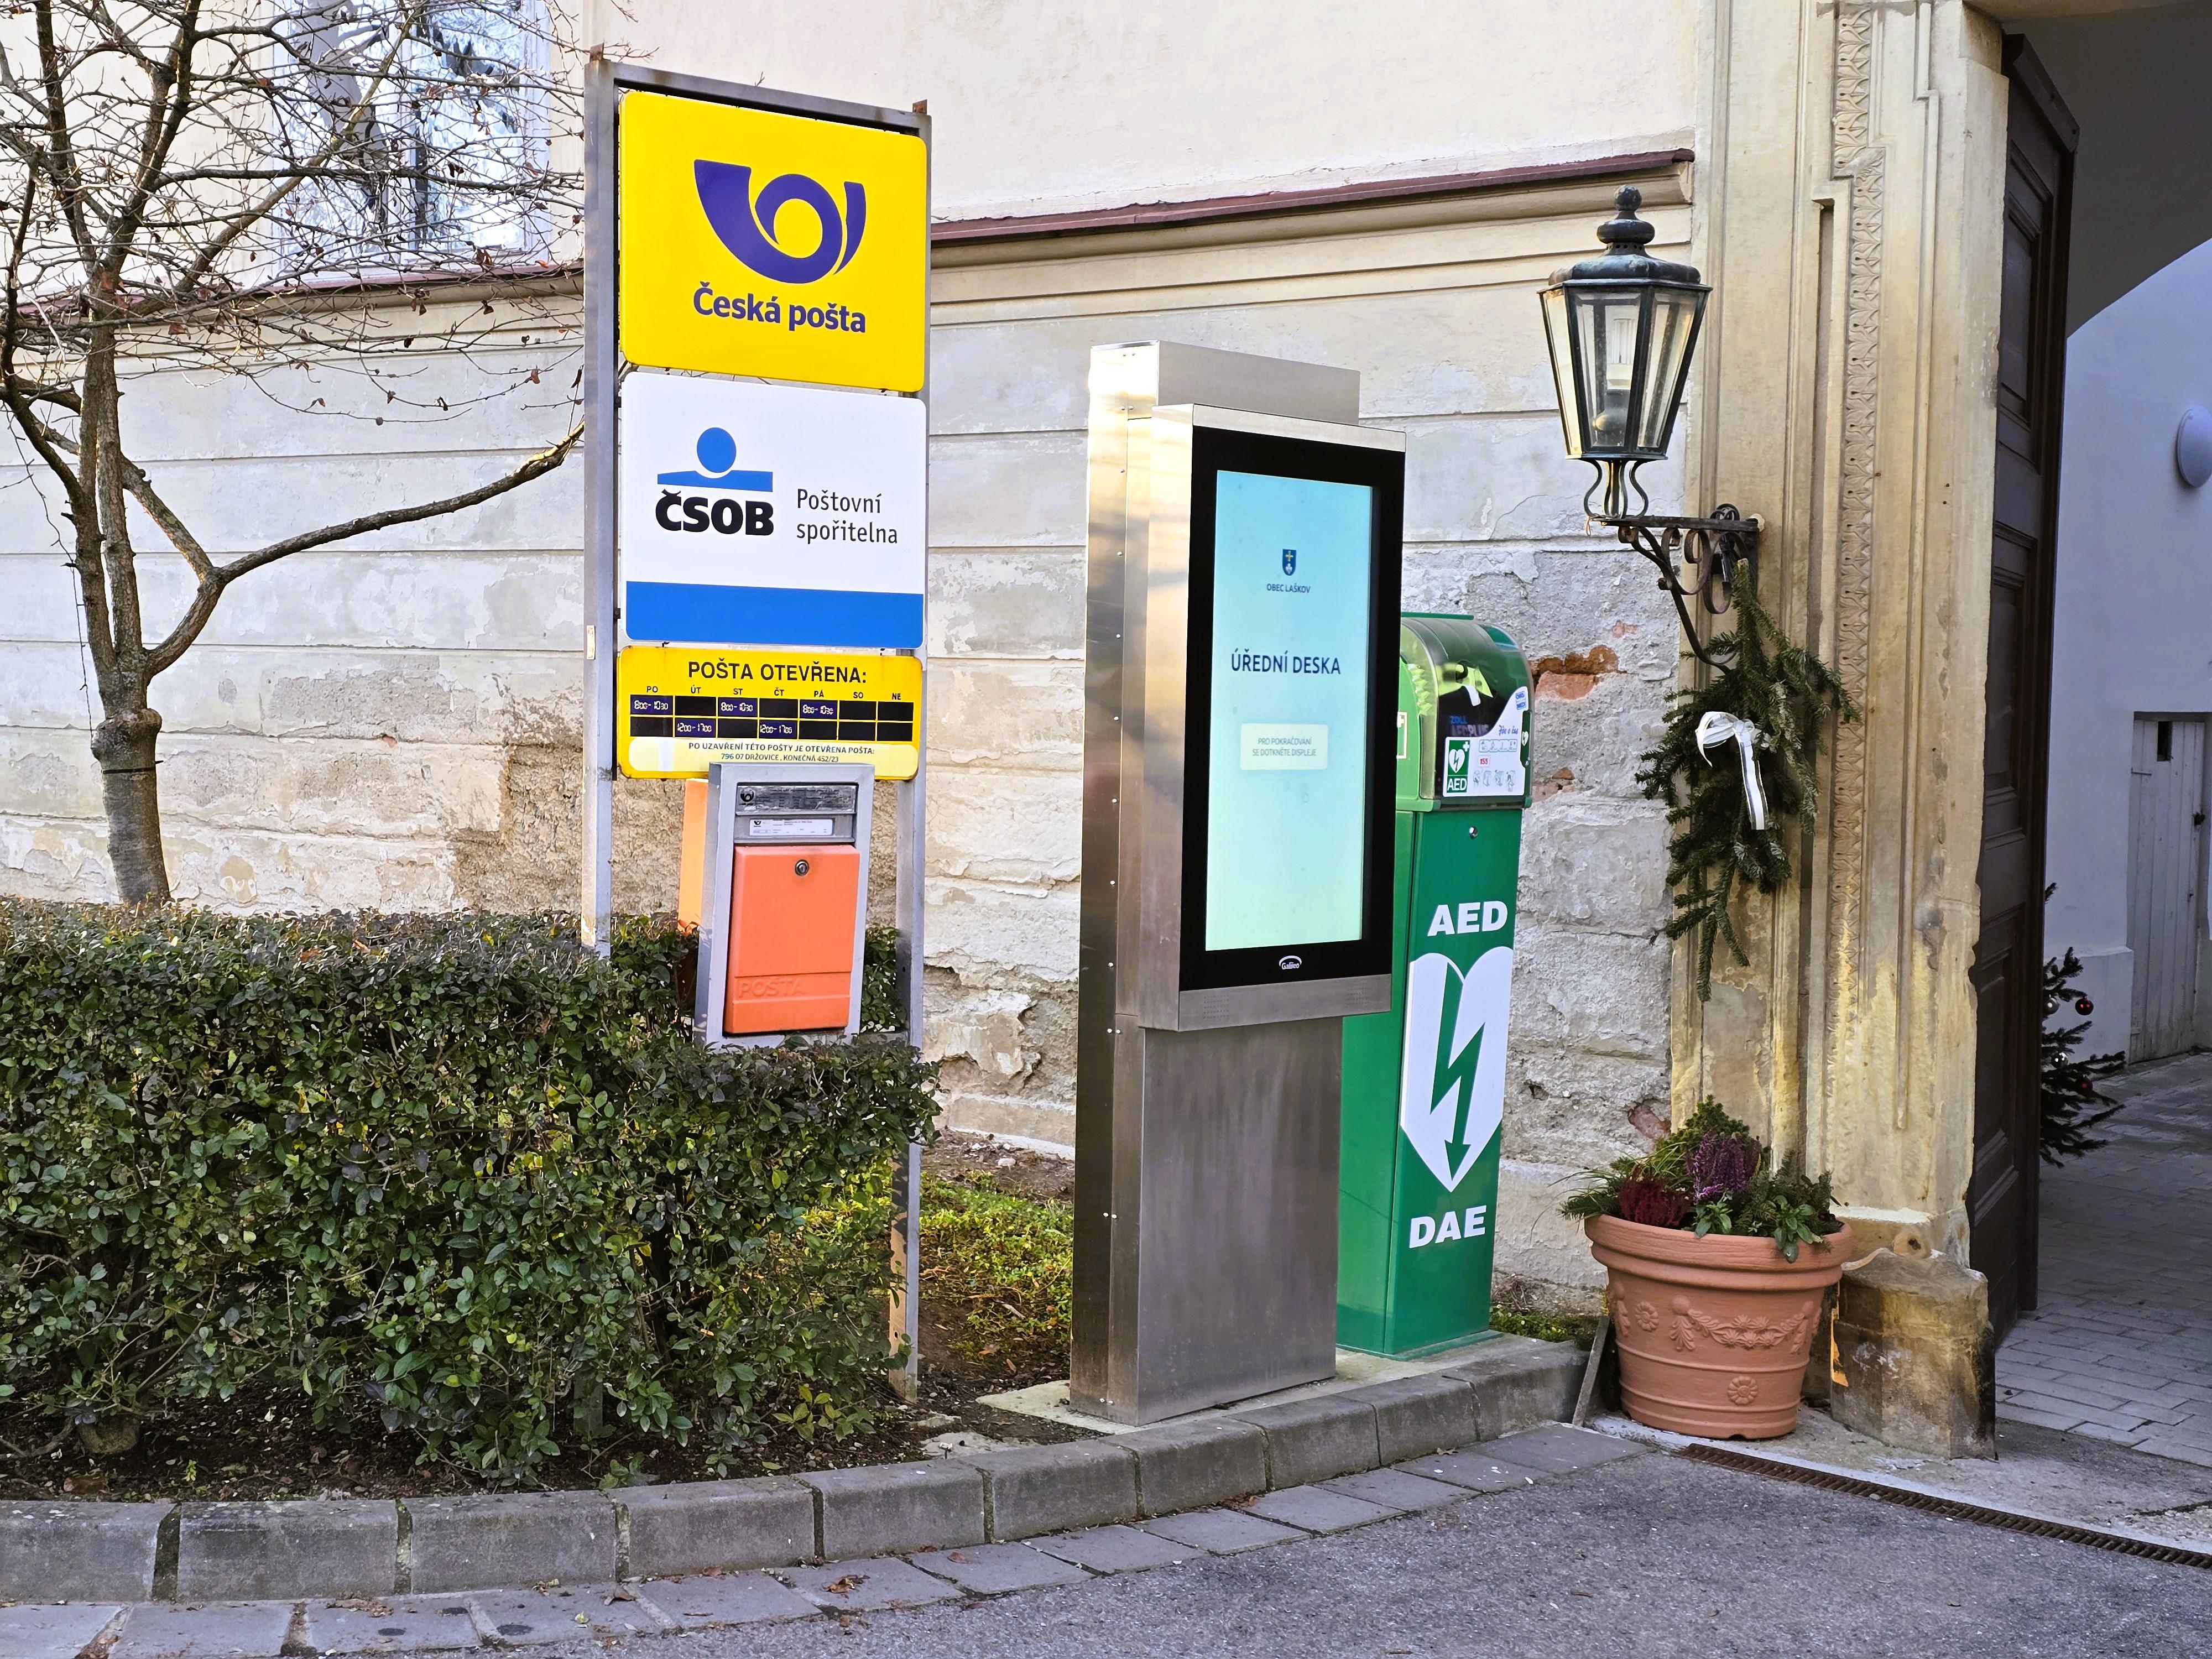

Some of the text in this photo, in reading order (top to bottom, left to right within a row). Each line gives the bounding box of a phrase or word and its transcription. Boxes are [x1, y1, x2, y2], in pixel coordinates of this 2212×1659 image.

[693, 281, 866, 333] Česká pošta
[655, 488, 774, 536] ČSOB
[797, 488, 882, 514] Poštovní
[796, 519, 898, 545] spořitelna
[1266, 583, 1311, 593] OBEC LAŠKOV
[688, 657, 867, 684] POŠTA OTEVŘENA:
[1231, 647, 1341, 675] ÚŘEDNÍ DESKA
[646, 685, 659, 693] PO
[690, 684, 702, 694] ÚT
[773, 687, 785, 697] ČT
[813, 689, 825, 698] PÁ
[702, 742, 743, 751] UZAVŘENÍ
[745, 742, 766, 751] TÉTO
[768, 744, 793, 753] POŠTY
[805, 745, 847, 754] OTEVŘENA
[1252, 747, 1317, 757] SE DOTKNĚTE DISPLEJE
[1258, 736, 1312, 746] PRO POKRAČOVÁNÍ
[783, 754, 816, 762] KONEČNÁ
[1447, 778, 1467, 791] AED
[1427, 901, 1508, 936] AED
[738, 975, 806, 998] POŠTA
[1408, 1204, 1486, 1249] DAE
